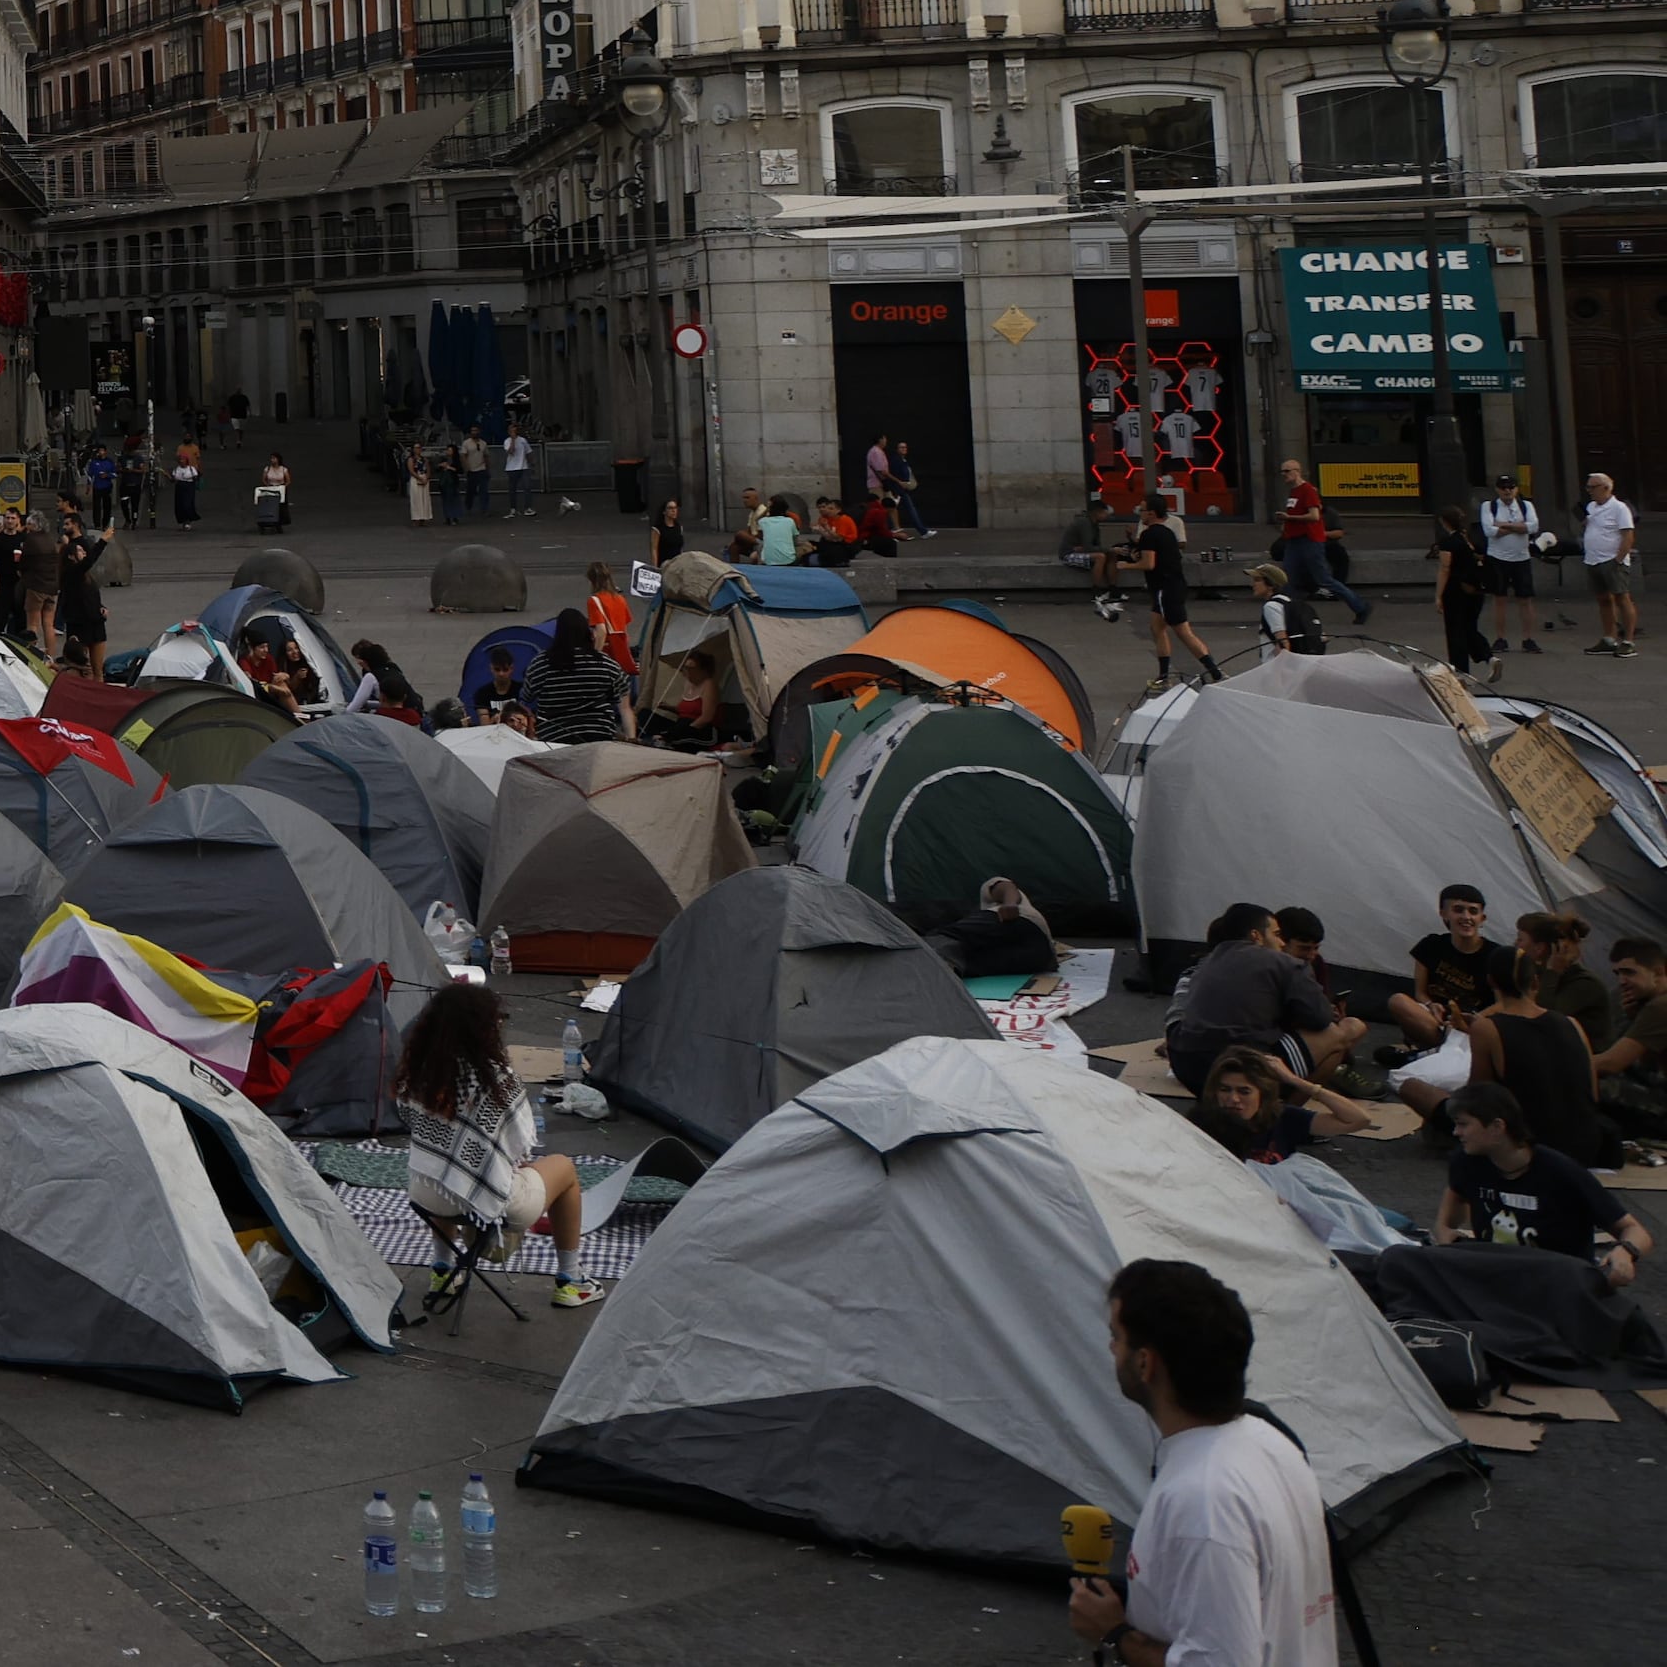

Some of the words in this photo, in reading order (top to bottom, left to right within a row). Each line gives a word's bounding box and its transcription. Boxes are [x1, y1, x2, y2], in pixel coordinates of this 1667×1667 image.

[1299, 249, 1470, 273] CHANGE
[850, 300, 948, 326] Orange
[1304, 293, 1476, 313] TRANSFER
[1145, 315, 1174, 327] range
